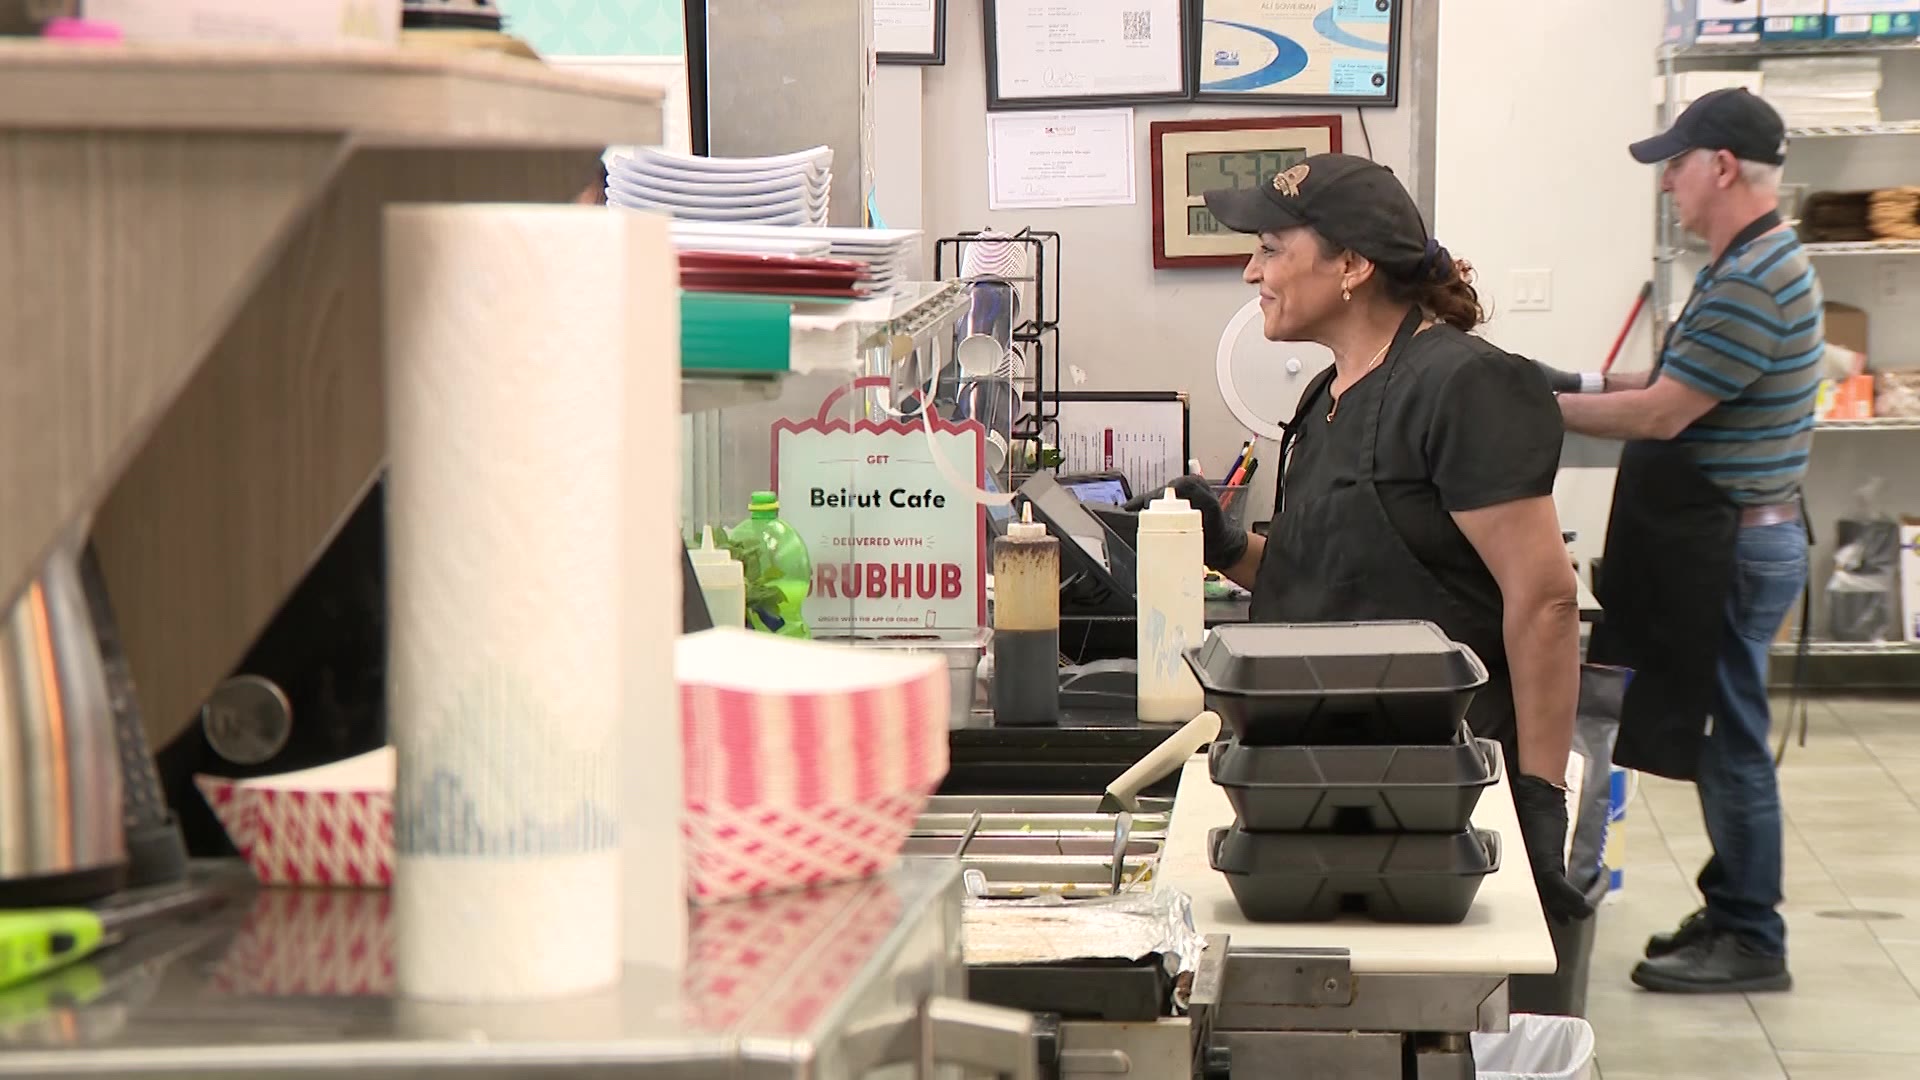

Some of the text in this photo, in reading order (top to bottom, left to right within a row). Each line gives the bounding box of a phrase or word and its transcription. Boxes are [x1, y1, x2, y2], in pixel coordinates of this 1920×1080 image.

[867, 455, 890, 465] GET
[810, 487, 946, 509] Beirut Cafe
[833, 537, 923, 547] DELIVERED WITH
[807, 563, 962, 600] RUBHUB
